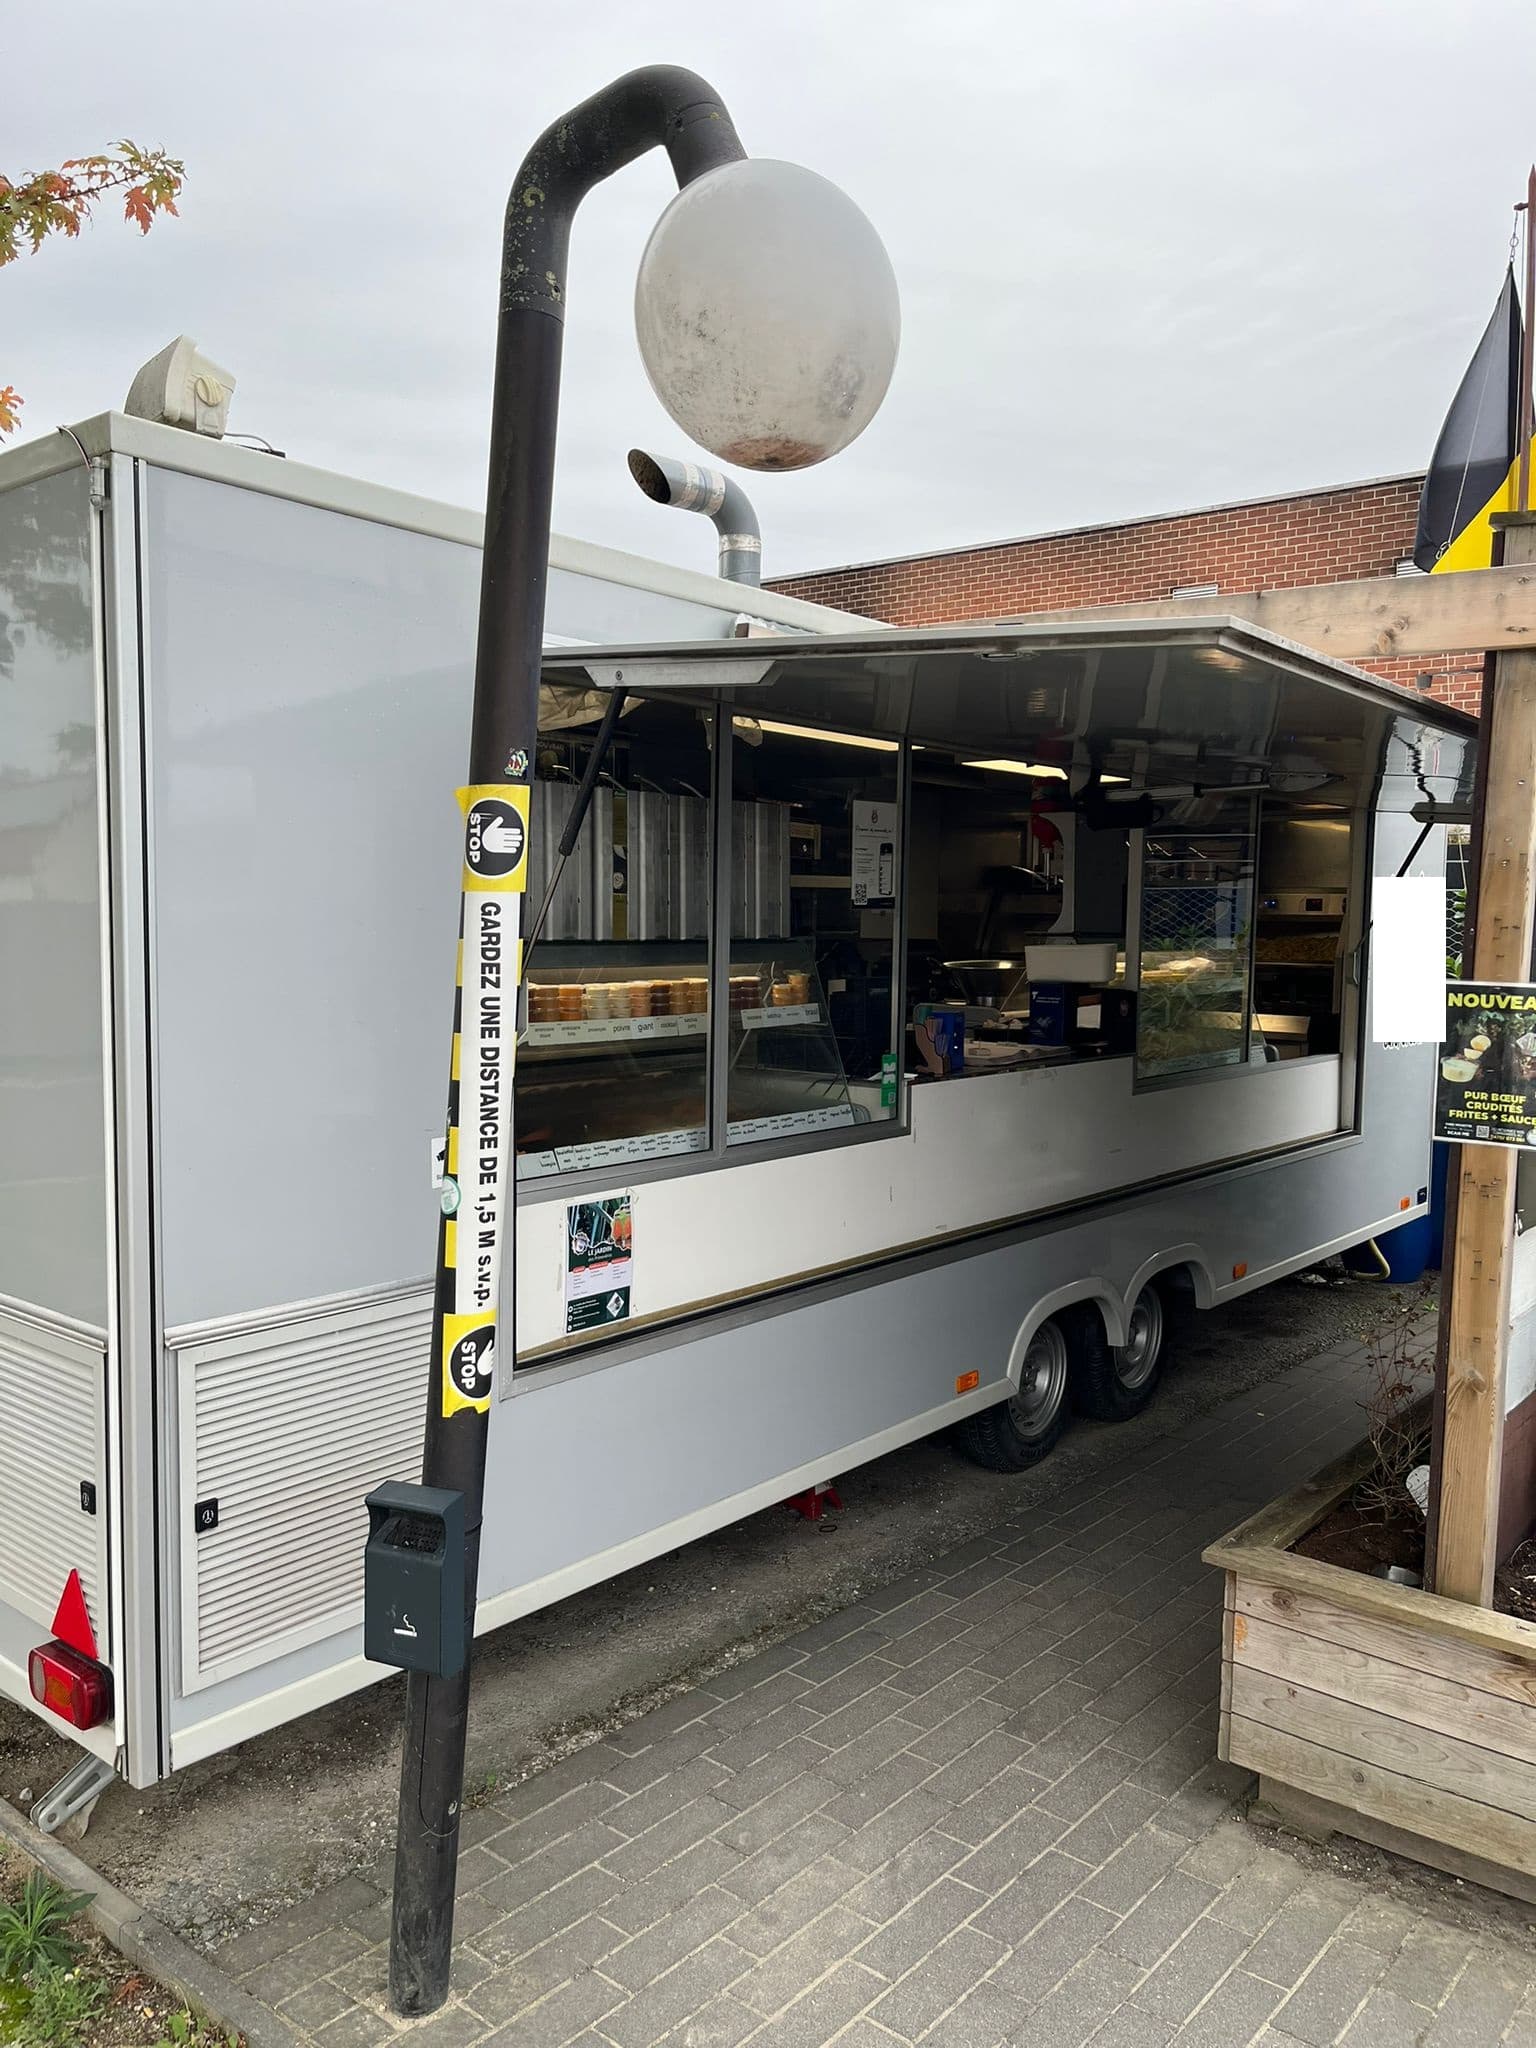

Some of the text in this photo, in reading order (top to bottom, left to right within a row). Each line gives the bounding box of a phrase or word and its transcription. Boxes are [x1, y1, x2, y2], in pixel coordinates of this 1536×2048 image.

[469, 812, 481, 864] STOP
[473, 902, 502, 1307] GARDEZ UNE DISTANCE DE 1,5 M s.v.p.
[1464, 1091, 1527, 1104] PUR BŒUF
[1466, 1101, 1523, 1114] CRUDITÉS
[1449, 1109, 1489, 1120] FRITES
[461, 1340, 477, 1390] STOP
